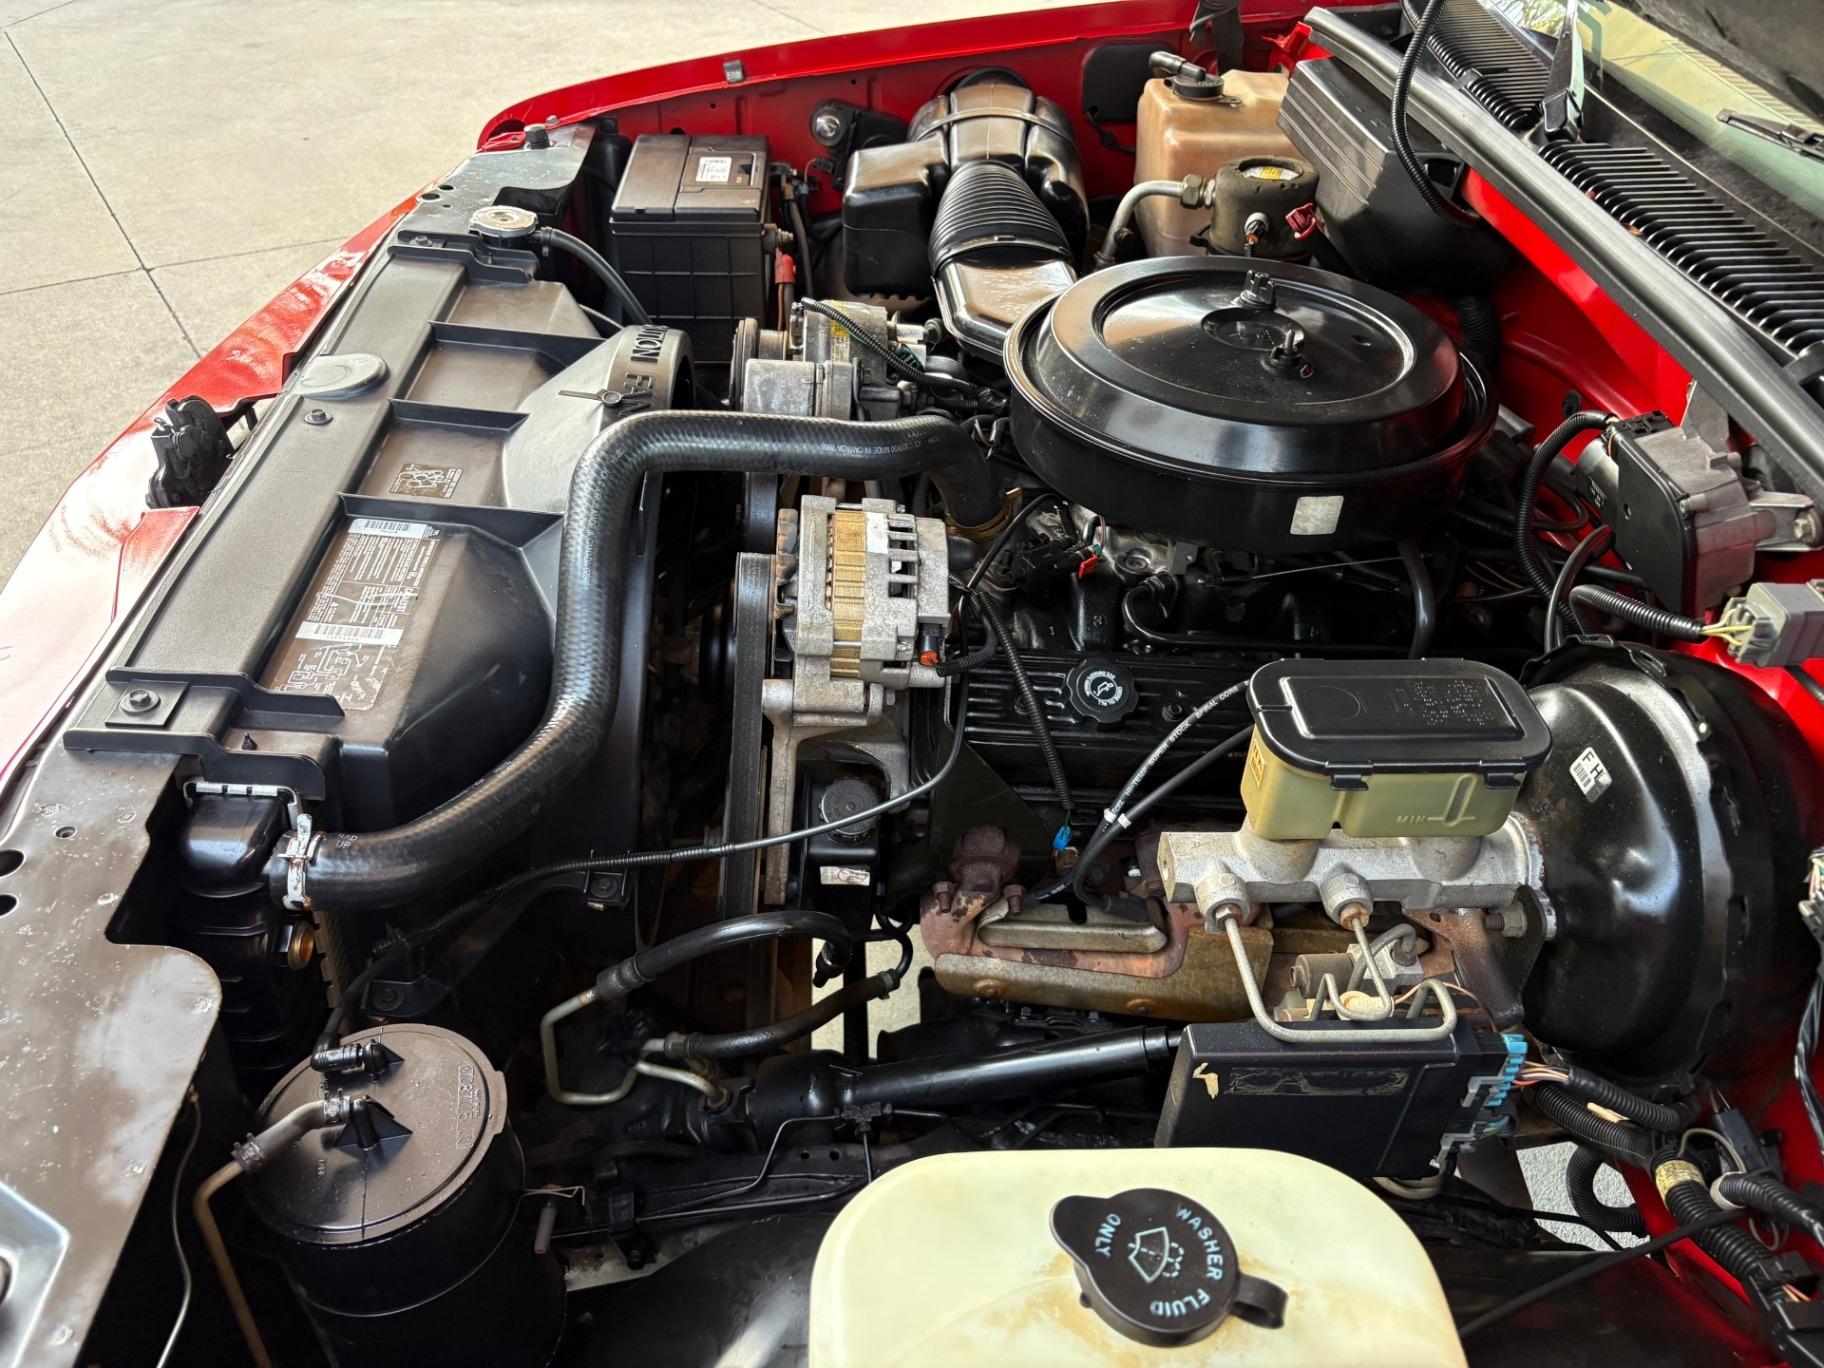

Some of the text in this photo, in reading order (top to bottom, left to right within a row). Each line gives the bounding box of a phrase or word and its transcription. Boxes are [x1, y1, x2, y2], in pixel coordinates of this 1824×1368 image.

[1124, 766, 1148, 797] HI-TEMP
[1149, 742, 1170, 767] SUPER
[1169, 719, 1192, 743] STOCK
[1195, 699, 1219, 719] SPIRAL
[1219, 685, 1240, 701] CORE
[1396, 814, 1426, 825] MIN
[1094, 1207, 1224, 1317] WASHER FLUID ONLY
